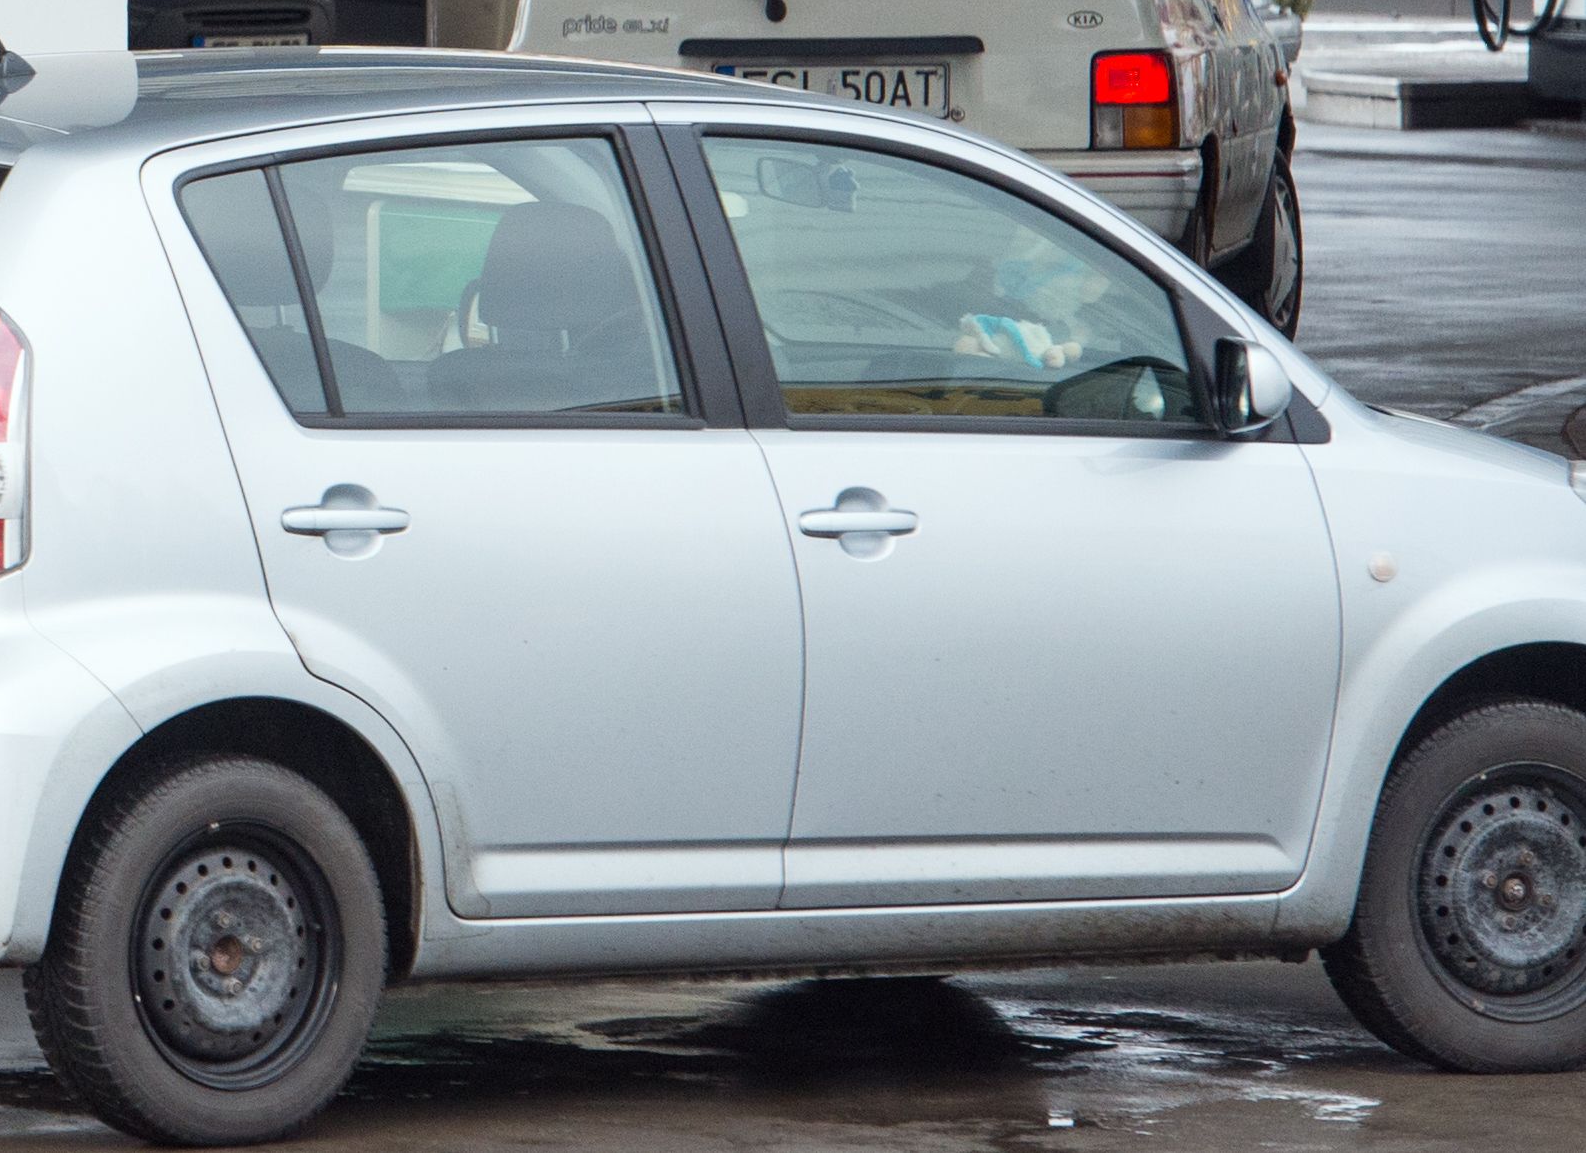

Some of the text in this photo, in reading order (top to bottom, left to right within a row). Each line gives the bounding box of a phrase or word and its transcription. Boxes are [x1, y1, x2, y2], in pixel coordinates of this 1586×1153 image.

[563, 14, 618, 35] pride
[1072, 13, 1098, 26] KIA
[841, 70, 937, 107] 50AT
